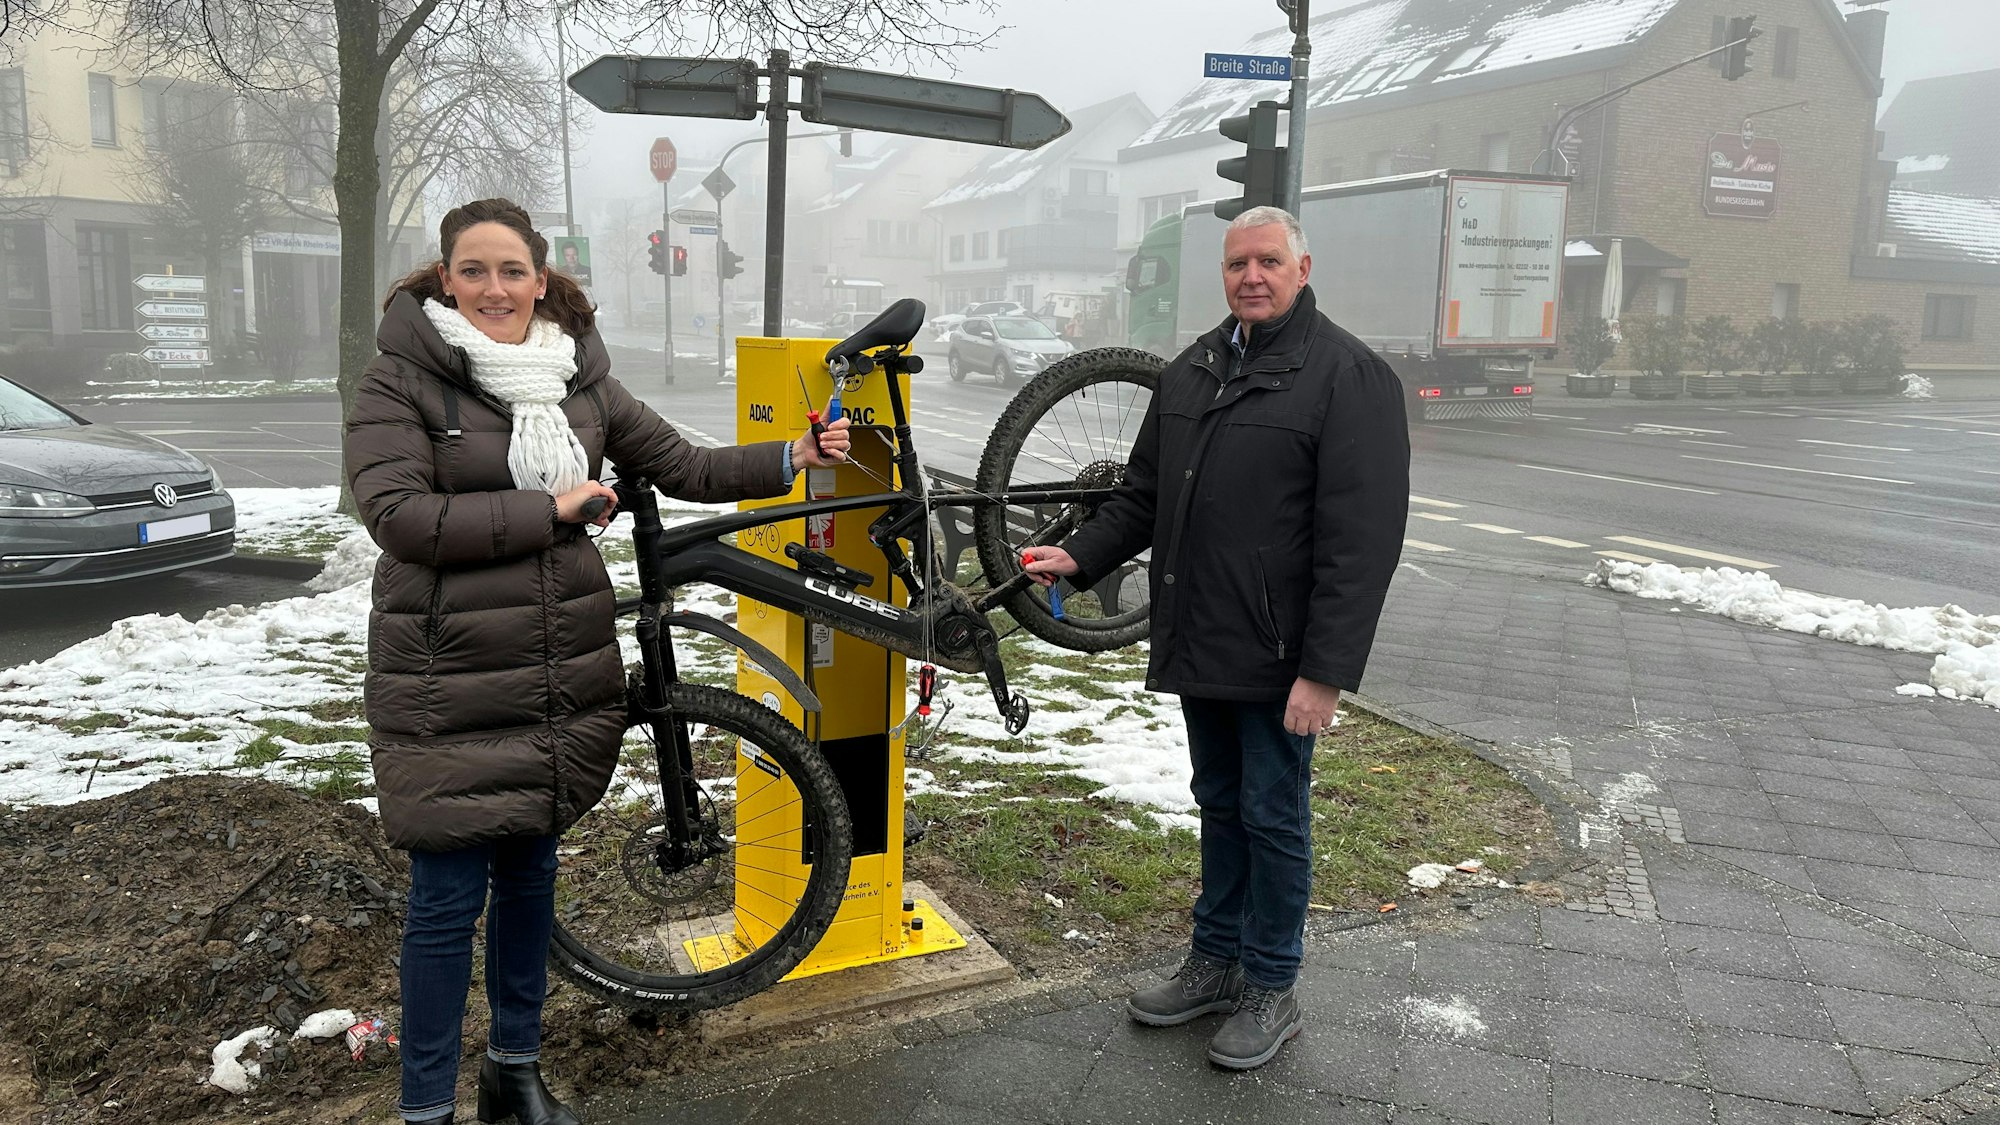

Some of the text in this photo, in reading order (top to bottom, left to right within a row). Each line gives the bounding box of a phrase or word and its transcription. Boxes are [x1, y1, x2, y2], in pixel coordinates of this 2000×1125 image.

[1209, 57, 1286, 75] Breite Straße
[652, 151, 674, 169] STOP
[1715, 195, 1765, 207] BUNDESKEGELBAHN
[1462, 218, 1478, 229] H&D
[168, 351, 192, 360] Ecke
[749, 403, 774, 424] ADAC
[841, 407, 875, 425] DAC
[804, 576, 901, 621] CUBE
[858, 881, 871, 889] des
[571, 963, 675, 1000] SMART SAM
